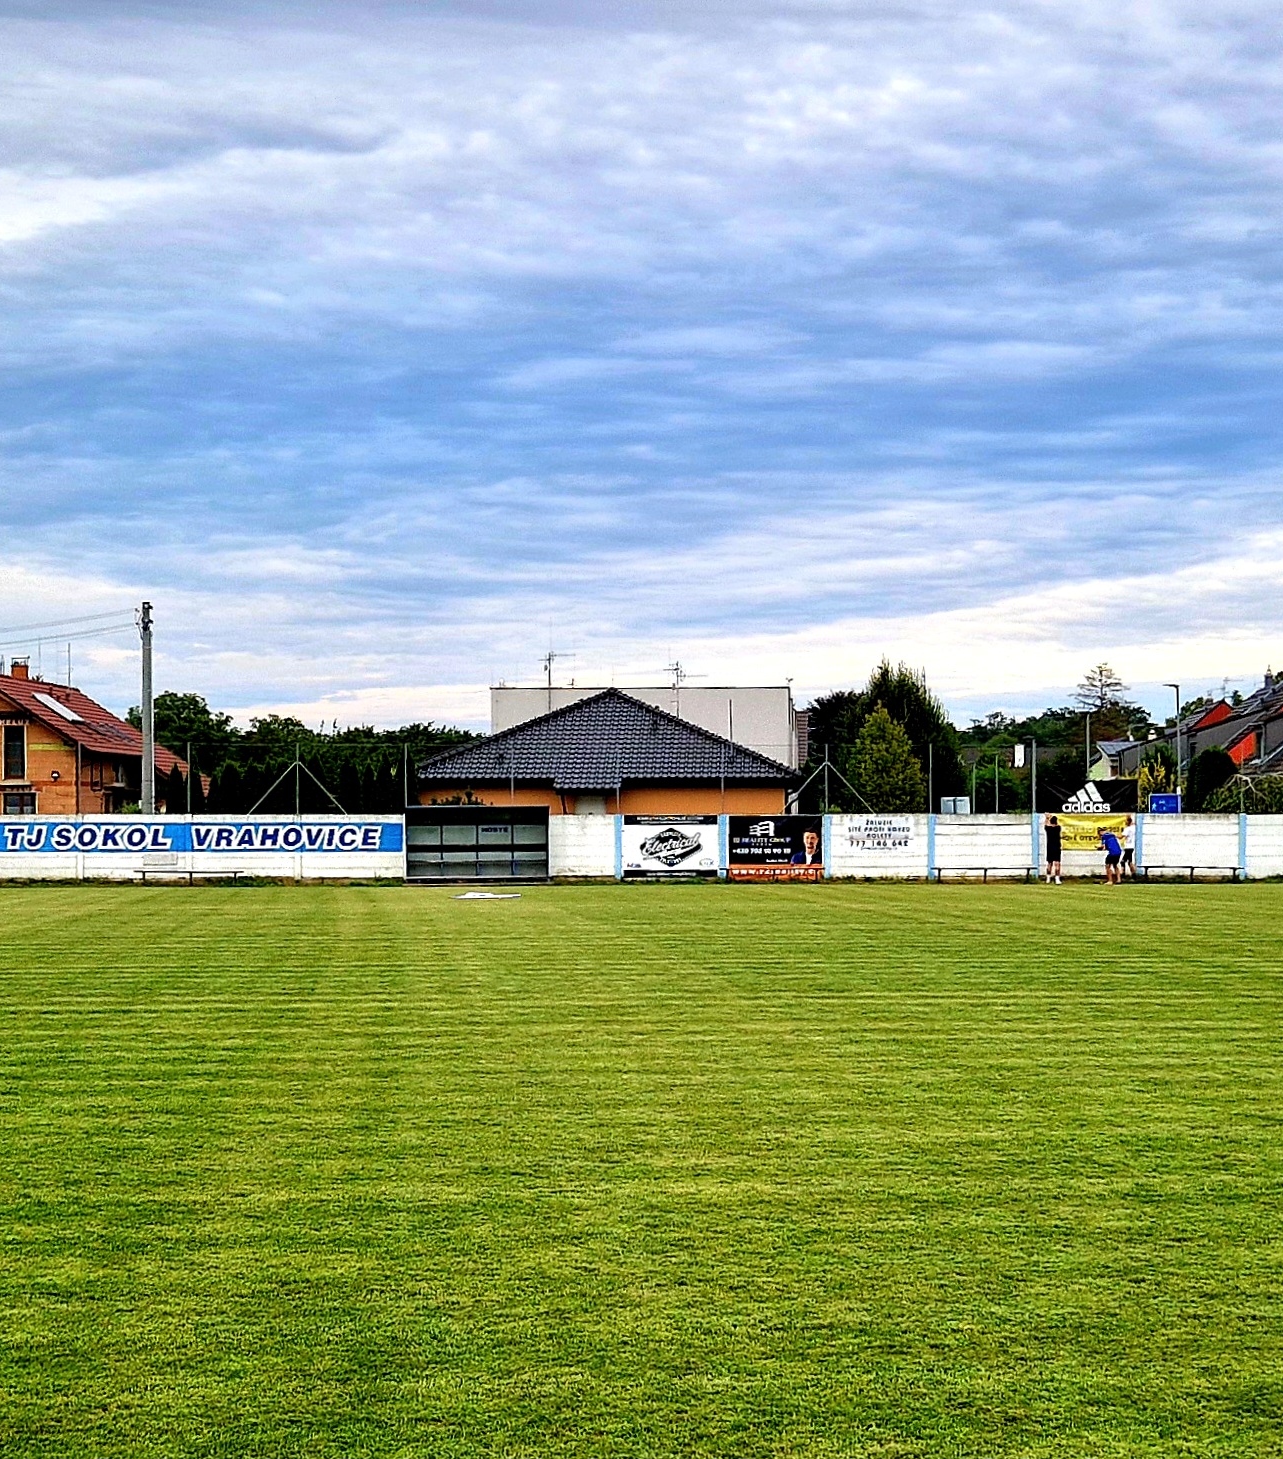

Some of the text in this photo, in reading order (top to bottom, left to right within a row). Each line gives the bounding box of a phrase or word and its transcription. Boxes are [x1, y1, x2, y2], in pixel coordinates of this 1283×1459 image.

[1062, 801, 1111, 813] adidas
[6, 826, 380, 849] TJ SOKOL VRAHOVICE
[642, 832, 701, 855] Electrical
